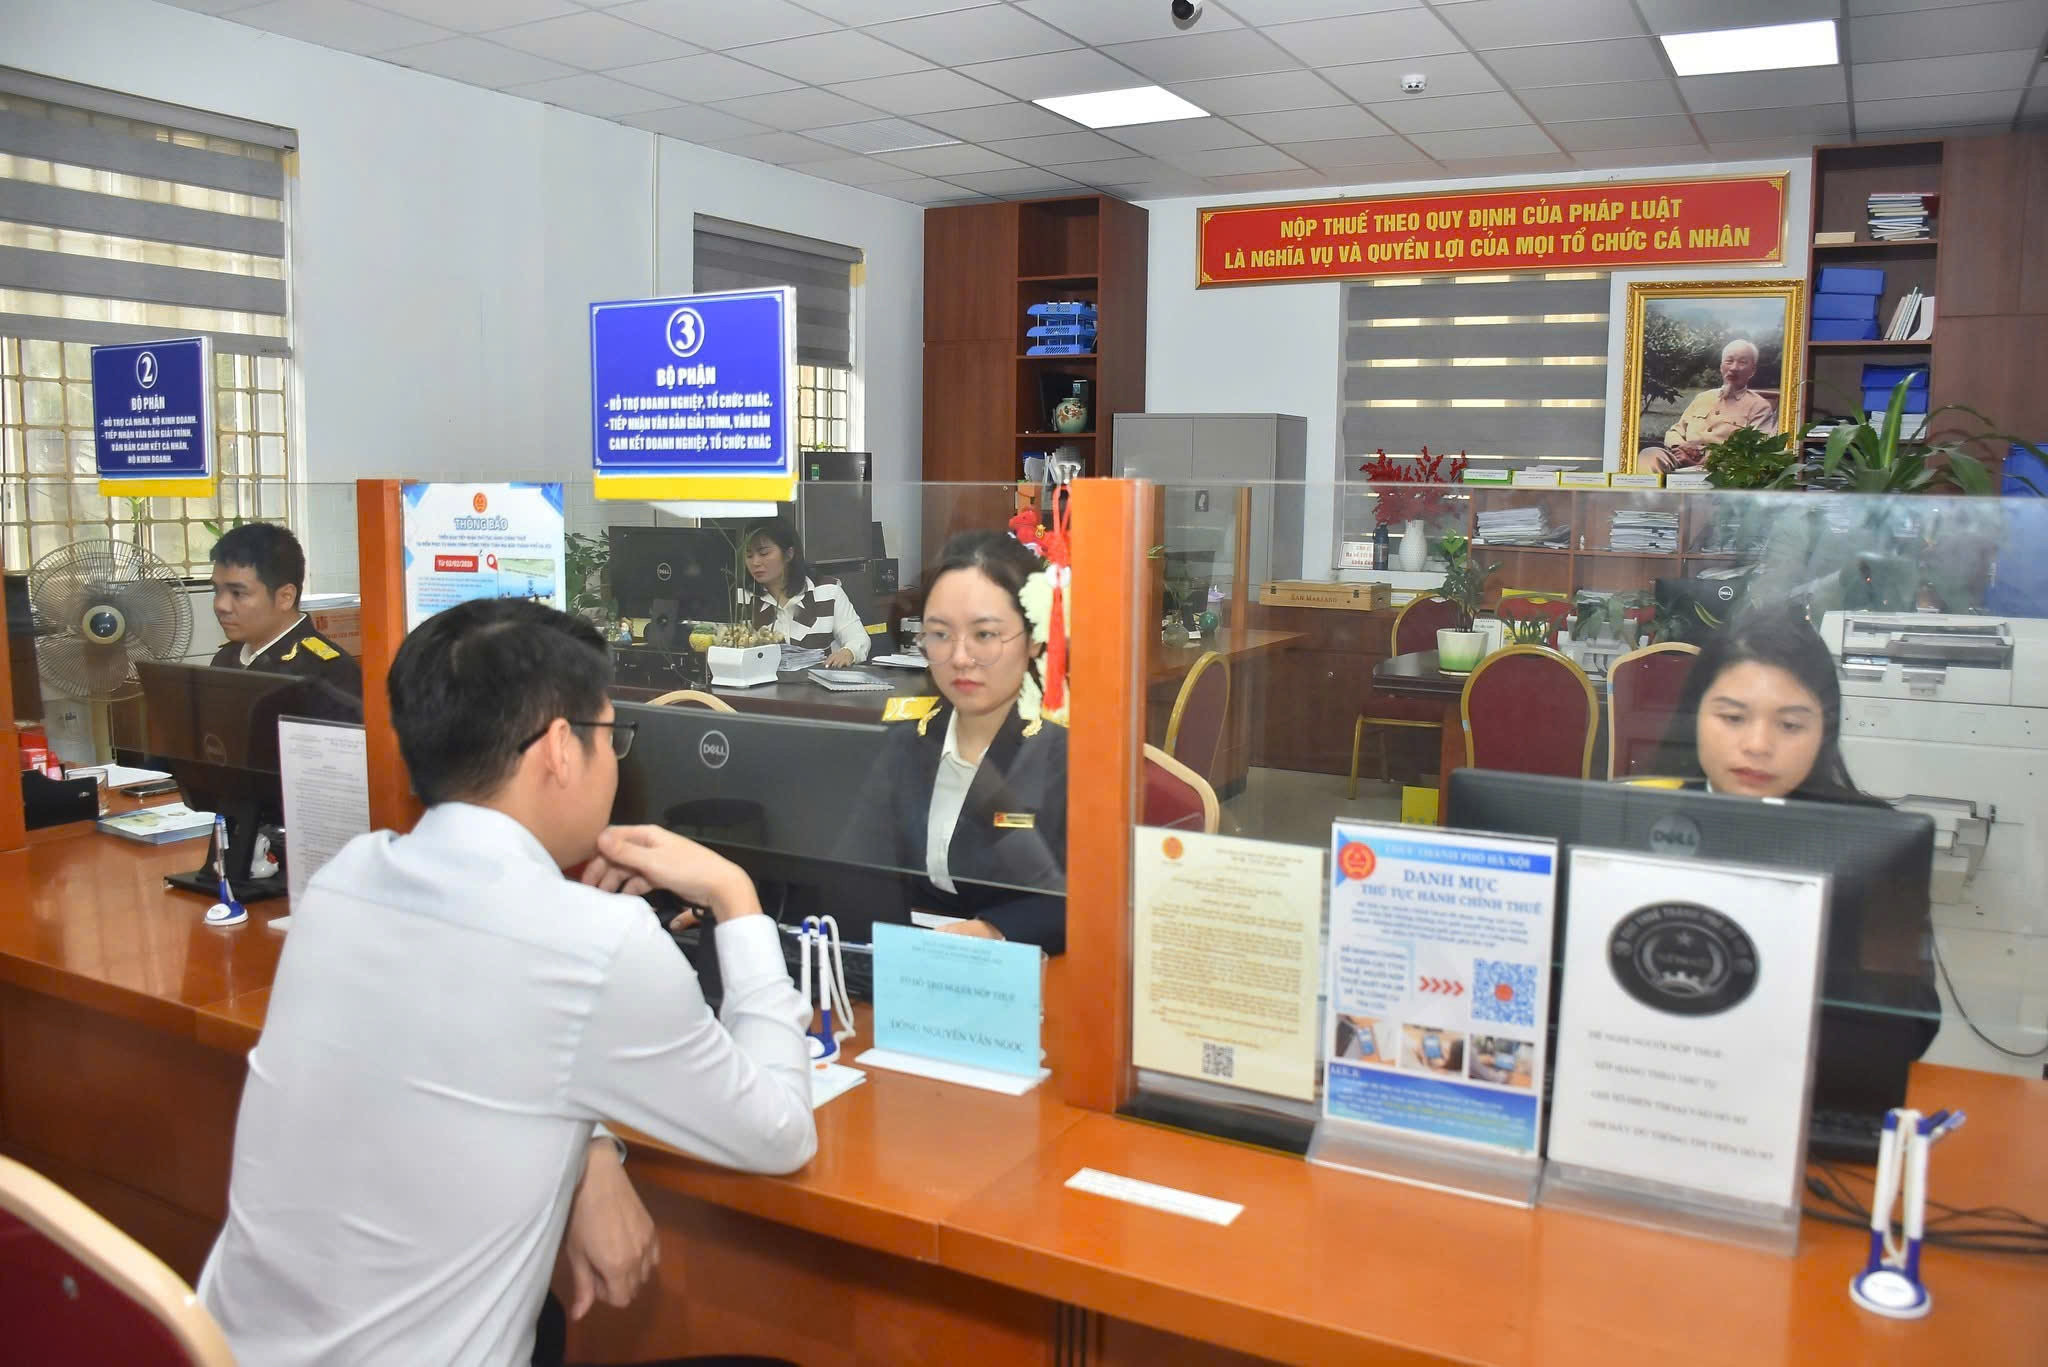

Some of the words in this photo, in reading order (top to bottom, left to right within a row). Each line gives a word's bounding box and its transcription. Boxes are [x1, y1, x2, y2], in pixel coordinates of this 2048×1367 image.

[1280, 216, 1317, 241] NỘP
[1323, 209, 1370, 236] THUẾ
[1374, 212, 1420, 233] THEO
[1426, 210, 1464, 231] QUY
[1468, 207, 1516, 231] ĐỊNH
[1522, 198, 1563, 225] CỦA
[1569, 198, 1625, 223] PHÁP
[1631, 195, 1683, 223] LUẬT
[1224, 248, 1246, 269] LÀ
[1251, 245, 1305, 268] NGHĨA
[1310, 246, 1333, 268] VỤ
[1338, 241, 1362, 264] VÀ
[1367, 235, 1430, 264] QUYỀN
[1435, 239, 1465, 262] LỢI
[1471, 230, 1509, 257] CỦA
[1516, 234, 1554, 258] MỌI
[1560, 227, 1587, 253] TỔ
[1591, 227, 1648, 251] CHỨC
[1653, 227, 1682, 249] CÁ
[1688, 224, 1750, 249] NHÂN
[675, 313, 696, 351] 3
[141, 356, 153, 383] 2
[656, 364, 676, 390] BỘ
[677, 363, 716, 389] PHẬN
[131, 395, 142, 413] BỘ
[143, 394, 165, 412] PHẬN
[640, 397, 670, 410] DOANH
[646, 437, 675, 450] DOANH
[1403, 868, 1455, 889] DANH
[1458, 874, 1499, 896] MỤC
